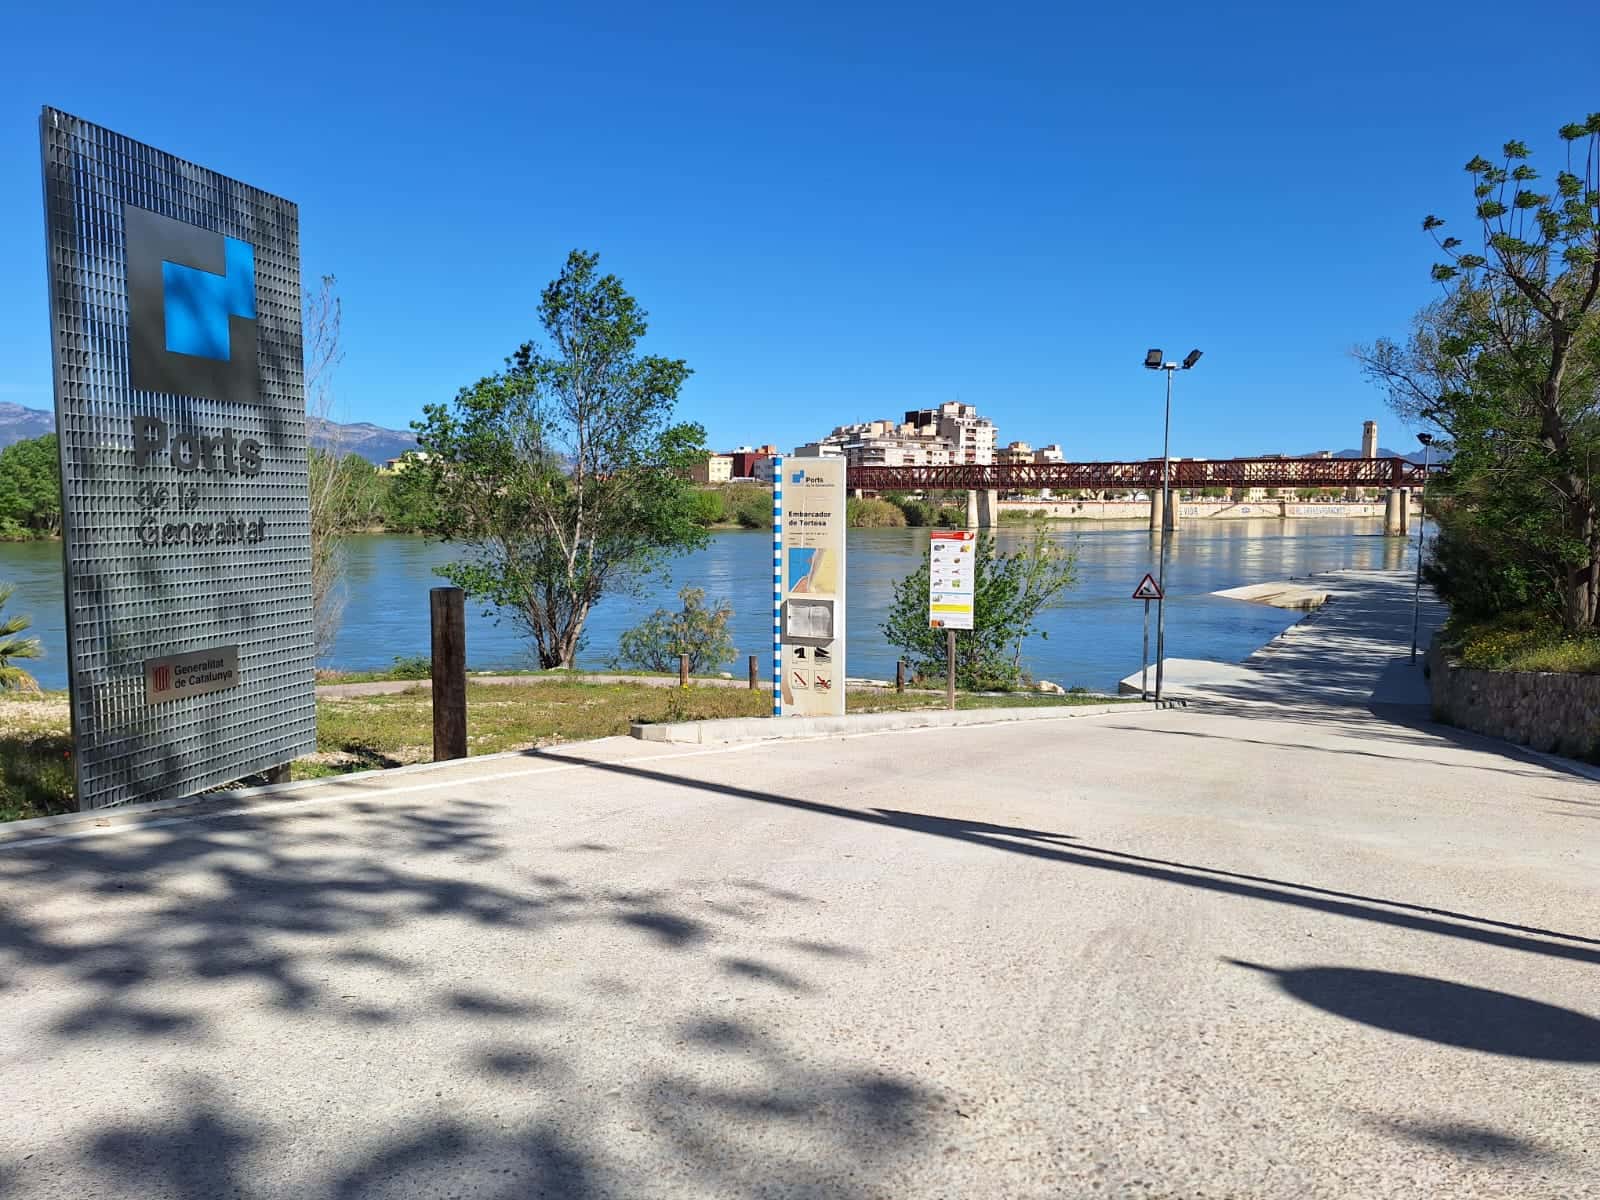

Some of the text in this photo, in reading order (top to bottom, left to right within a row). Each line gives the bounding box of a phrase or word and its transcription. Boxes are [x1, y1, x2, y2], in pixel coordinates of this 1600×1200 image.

[134, 415, 262, 475] Ports
[138, 480, 199, 510] de la
[788, 510, 831, 518] Embarcador
[800, 519, 827, 527] Tortosa
[137, 516, 266, 544] Generalitat
[174, 658, 224, 675] Generalitat
[174, 669, 233, 688] de Catalunya
